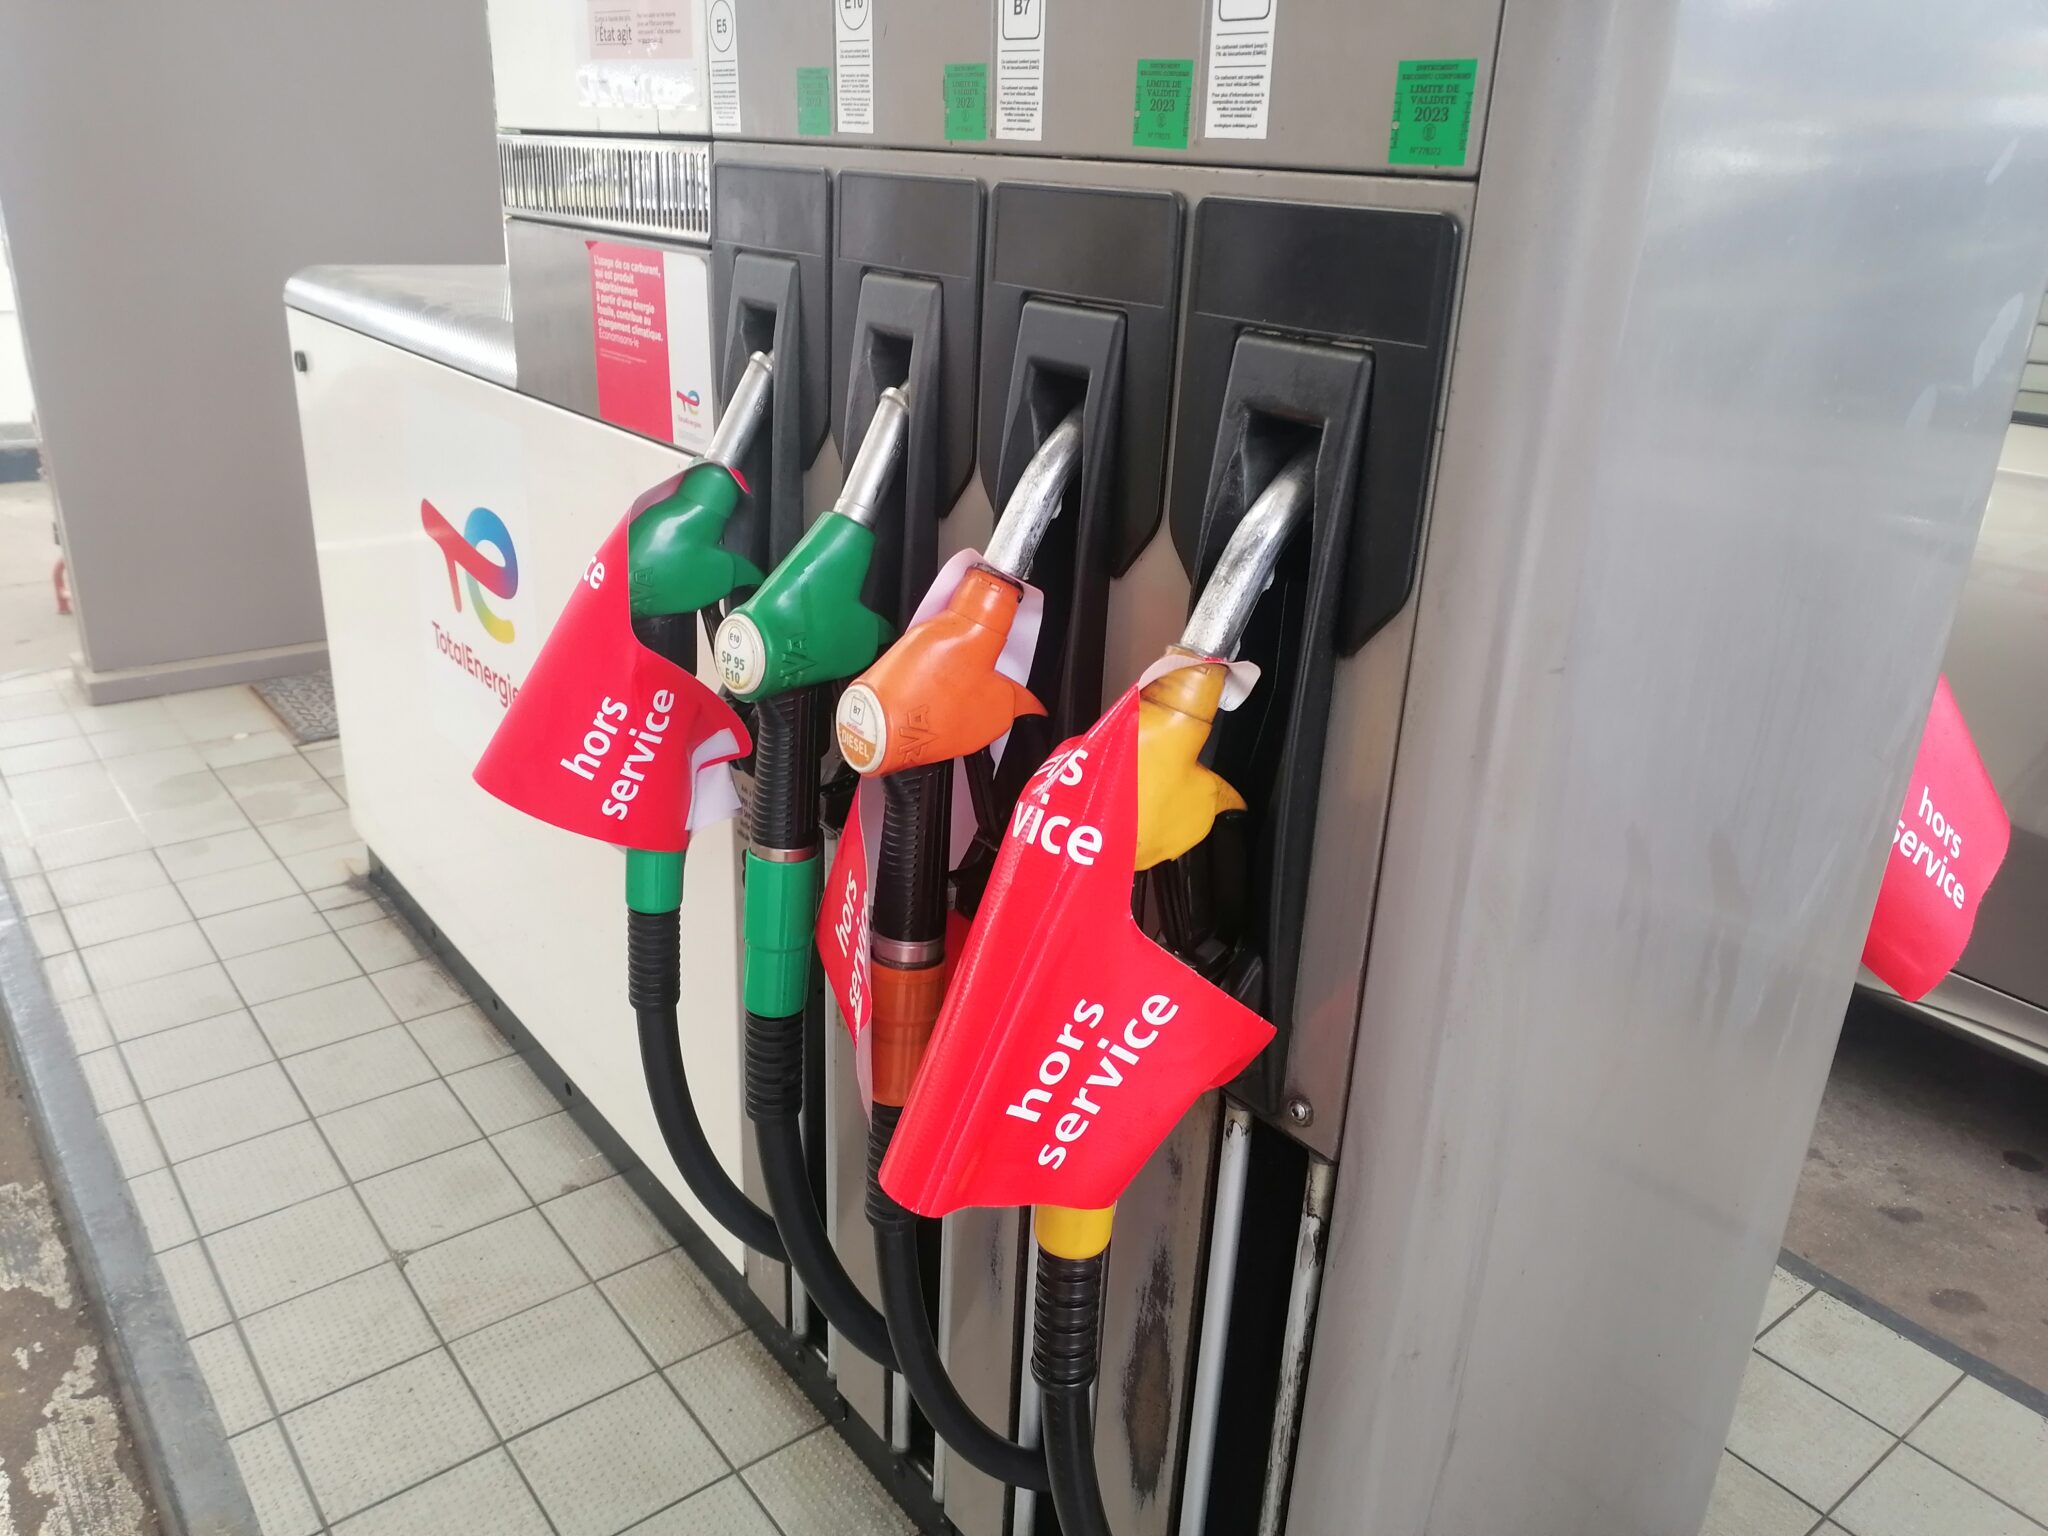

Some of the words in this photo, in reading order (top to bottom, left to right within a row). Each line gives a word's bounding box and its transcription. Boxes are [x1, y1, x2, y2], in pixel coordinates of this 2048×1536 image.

[1013, 0, 1031, 15] B7
[617, 24, 632, 46] agit
[716, 18, 728, 33] E5
[1410, 84, 1444, 93] LIMITE
[1446, 84, 1460, 93] DE
[1150, 98, 1175, 112] 2023
[1413, 106, 1450, 122] 2023
[729, 632, 740, 644] E10
[432, 620, 519, 708] TotalEnergi
[722, 650, 732, 665] SP
[734, 656, 745, 671] 95
[725, 668, 740, 684] E10
[853, 705, 861, 716] B7
[560, 696, 629, 781] hors
[841, 729, 870, 761] DIESEL
[601, 688, 675, 821] service
[1012, 792, 1103, 866] vice
[1918, 785, 1962, 859] hors
[835, 869, 857, 959] hors
[1005, 998, 1105, 1123] hors
[1037, 994, 1180, 1171] service
